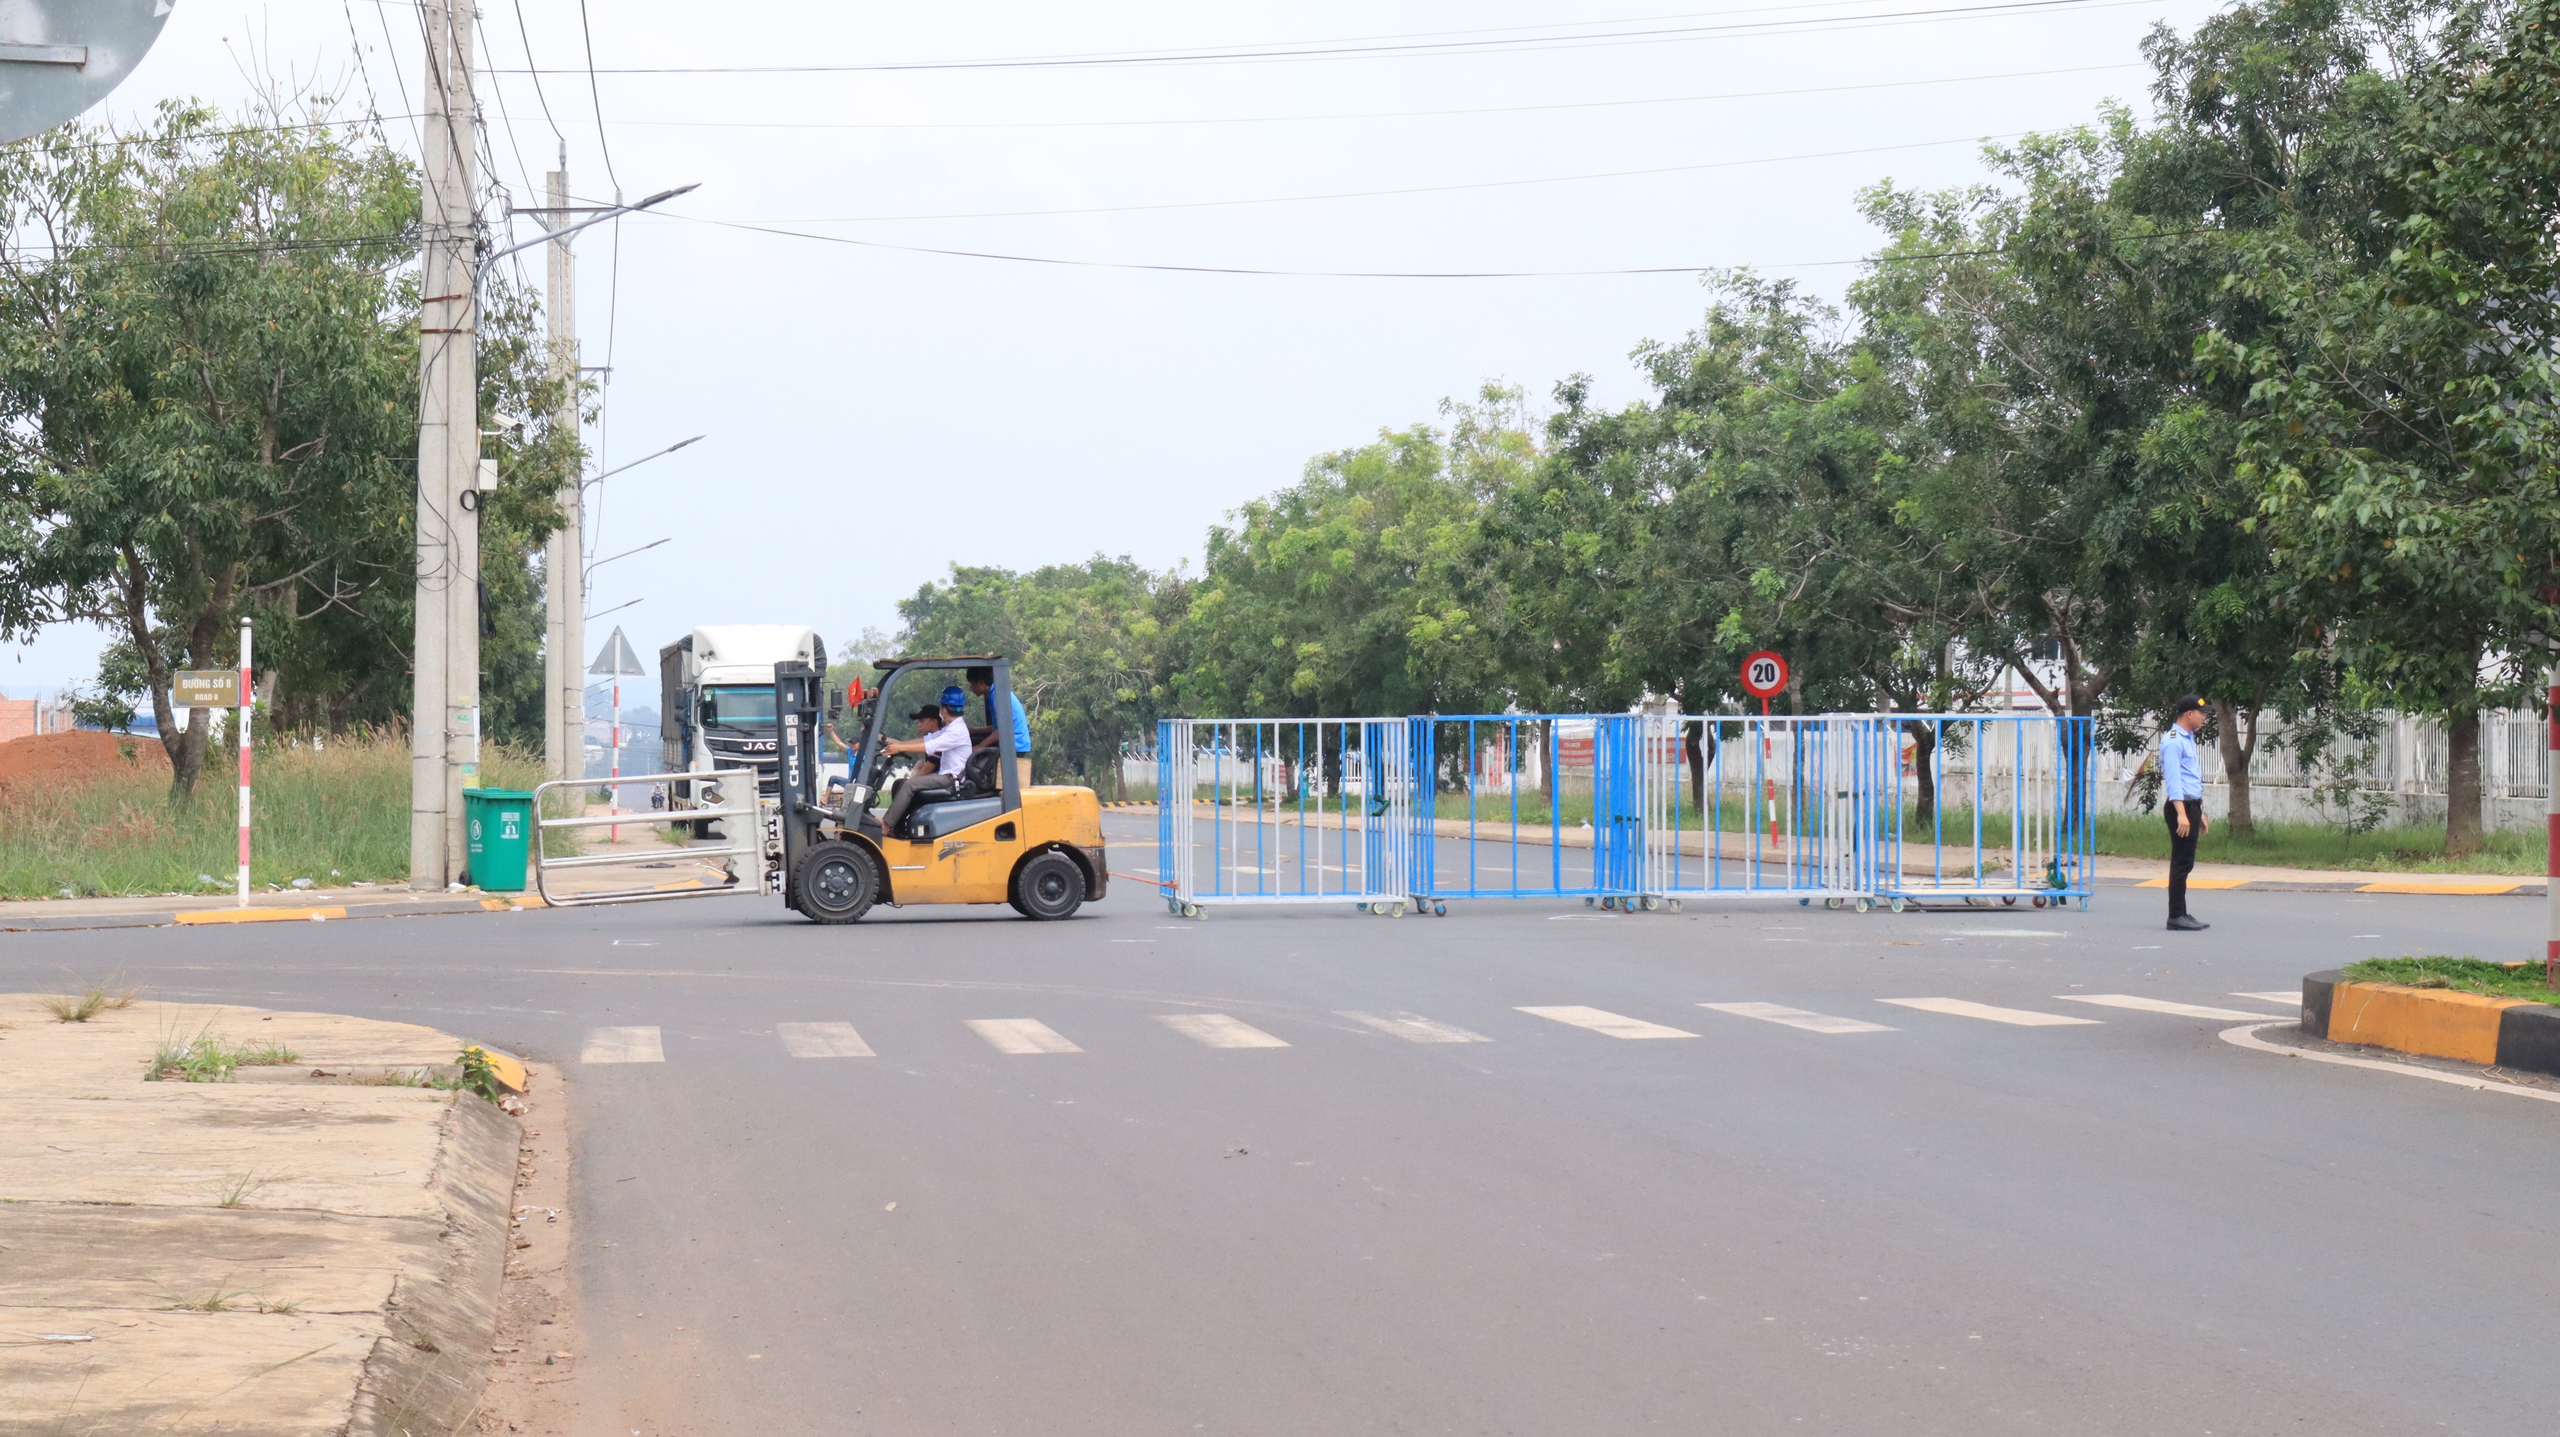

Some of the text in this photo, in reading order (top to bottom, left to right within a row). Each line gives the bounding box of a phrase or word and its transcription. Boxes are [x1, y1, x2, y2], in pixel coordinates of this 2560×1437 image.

[1753, 663, 1775, 683] 20
[182, 676, 232, 689] ĐƯỜNG SỐ 8
[194, 693, 219, 701] ROAD 8
[786, 715, 798, 724] CE
[743, 742, 777, 751] JAC
[788, 746, 799, 787] CHL
